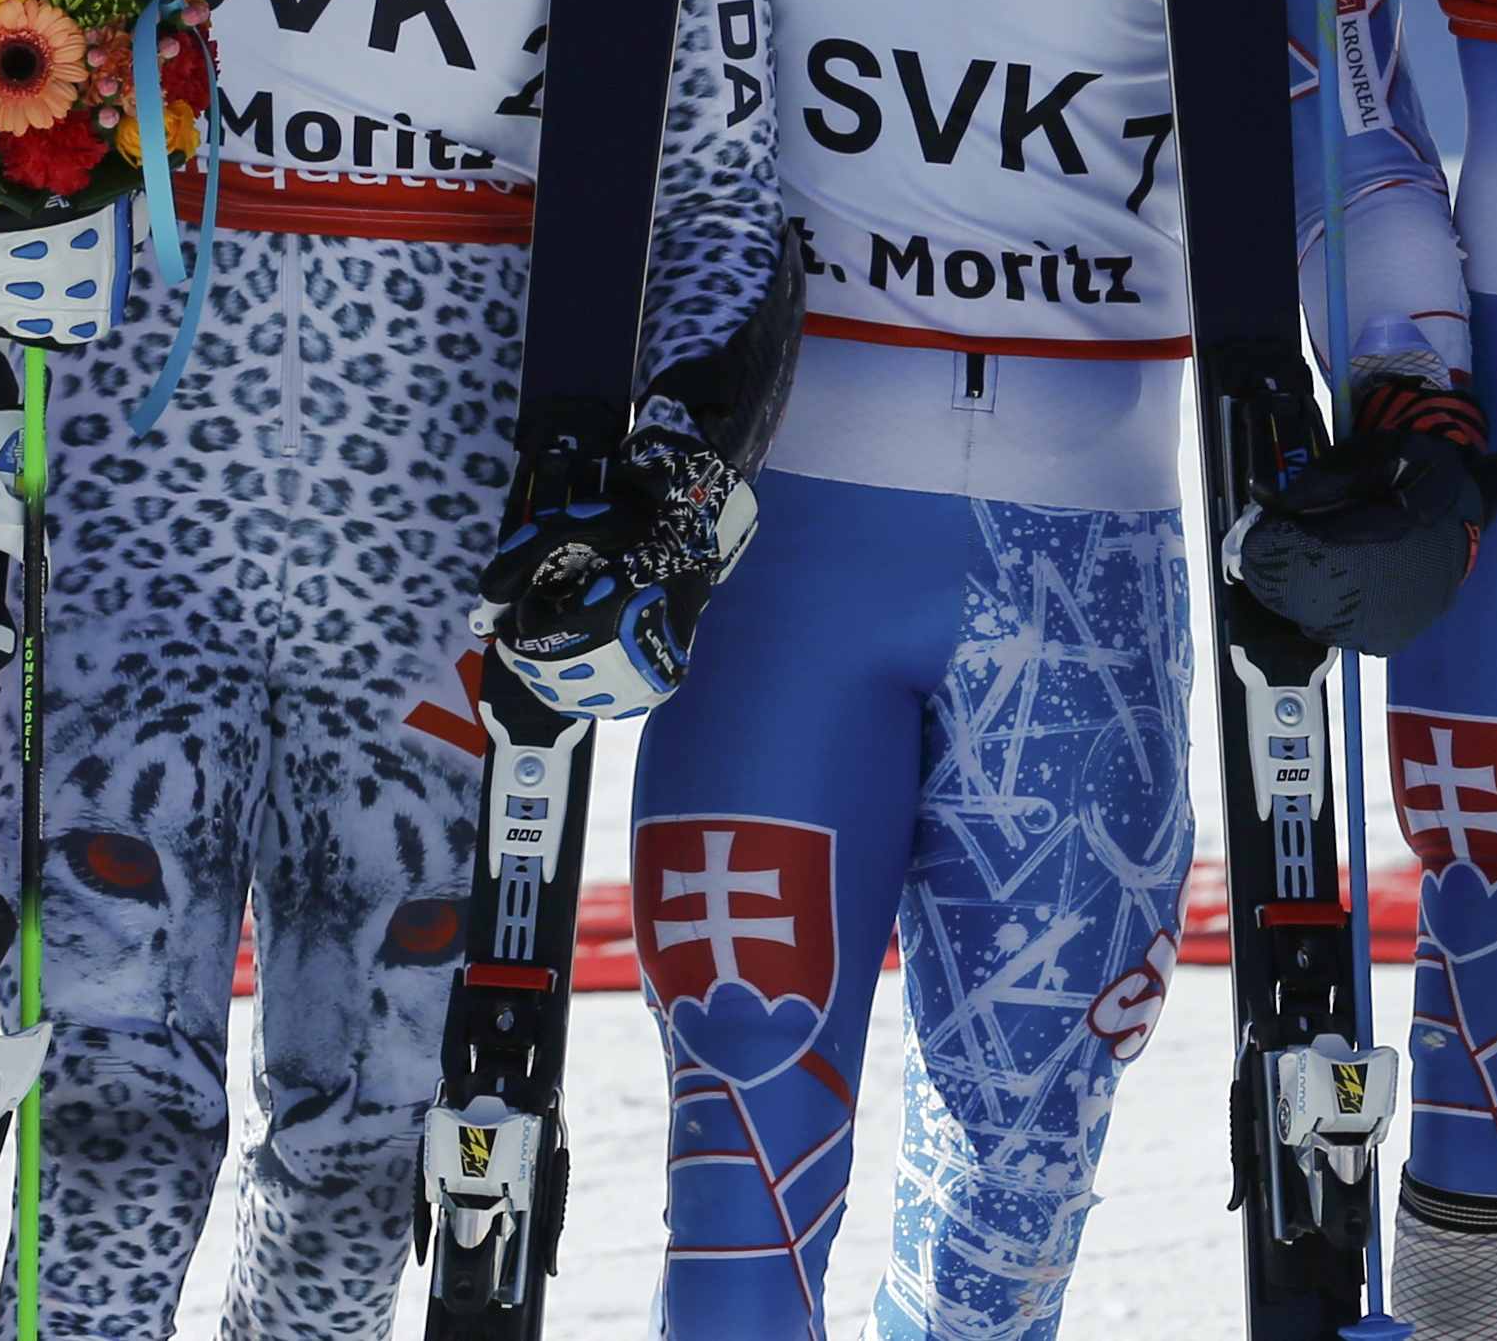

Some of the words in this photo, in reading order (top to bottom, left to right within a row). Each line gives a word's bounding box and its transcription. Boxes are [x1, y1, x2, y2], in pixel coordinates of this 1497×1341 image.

[802, 37, 1104, 177] SVK
[1339, 18, 1383, 130] KRONREAL
[1120, 114, 1174, 215] 7
[796, 216, 847, 285] t.
[867, 234, 1141, 305] Moritz
[515, 629, 581, 655] LEVEL
[24, 636, 35, 762] KOMPERDELL
